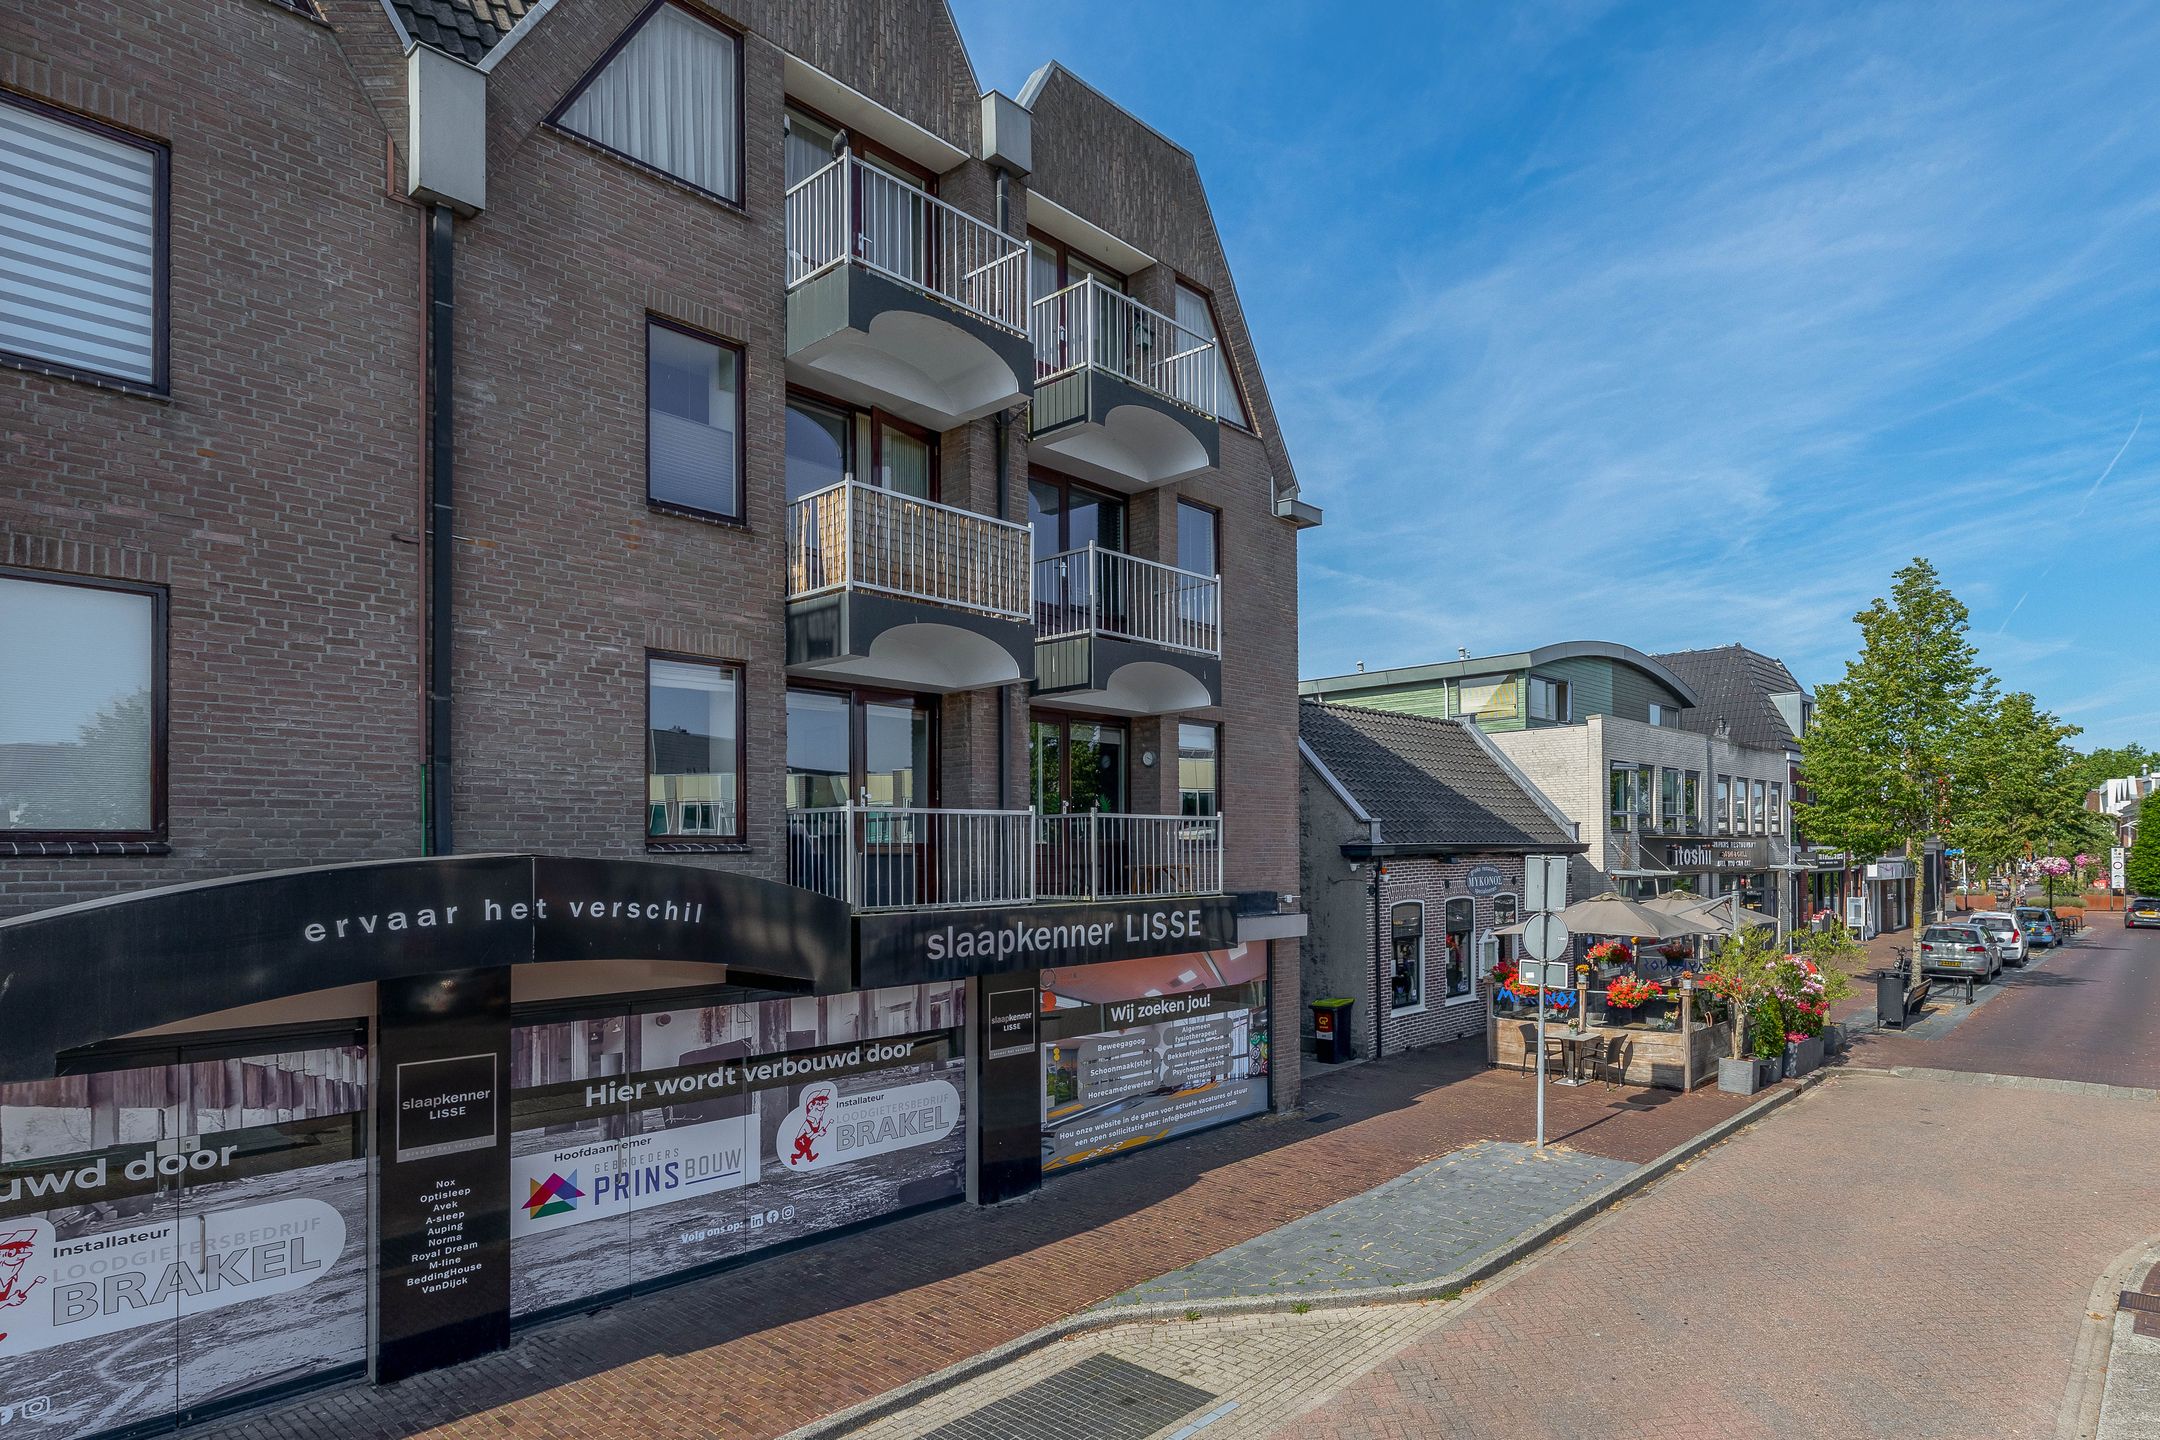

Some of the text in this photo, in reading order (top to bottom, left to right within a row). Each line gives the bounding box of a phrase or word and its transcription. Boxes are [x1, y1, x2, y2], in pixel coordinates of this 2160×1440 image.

[304, 898, 702, 943] ervaar het verschil
[927, 909, 1200, 961] slaapkenner LISSE
[991, 1012, 1032, 1025] slaapkenner
[1110, 994, 1211, 1023] Wij zoeken jou!
[1003, 1022, 1021, 1032] LISSE
[1174, 1029, 1217, 1043] fysiotherapeut
[1181, 1023, 1211, 1034] Algemeen
[1097, 1037, 1146, 1052] Beweegagoog
[1167, 1042, 1231, 1061] Bekkenfysiotherapeut
[585, 1041, 915, 1108] Hier wordt verbouwd door
[1090, 1058, 1152, 1077] Schoonmaak(st)er
[1172, 1059, 1225, 1076] Psychosomatische
[1187, 1069, 1211, 1081] therapie
[402, 1089, 491, 1110] slaapkenner
[1087, 1079, 1155, 1100] Horecamedewerker
[836, 1094, 885, 1109] Installateur
[836, 1093, 949, 1124] LOODGIETERSBEDRIJF
[429, 1106, 466, 1120] LISSE
[1059, 1087, 1248, 1140] Hou onze website in de gaten voor actuele vacatures of stuur
[1074, 1099, 1237, 1147] een open sollicitatie naar: info@bootenbroersen.com
[836, 1106, 950, 1151] BRAKEL
[124, 1144, 238, 1181] door
[594, 1148, 679, 1174] GEBROEDERS
[436, 1179, 456, 1189] Nox
[594, 1147, 741, 1206] PRINS BOUW
[420, 1187, 471, 1203] Optisleep
[433, 1200, 458, 1212] Avek
[425, 1211, 465, 1225] A-sleep
[427, 1222, 464, 1236] Auping
[680, 1228, 705, 1245] Volg
[707, 1225, 725, 1237] ons
[726, 1220, 743, 1236] op:
[53, 1227, 171, 1259] Installateur
[53, 1217, 321, 1284] LOODGIETERSBEDRIJF
[428, 1234, 462, 1247] Norma
[411, 1241, 478, 1263] Royal Dream
[429, 1256, 461, 1270] M-line
[53, 1236, 322, 1327] BRAKEL
[406, 1263, 482, 1287] BeddingHouse
[422, 1277, 468, 1294] VanDijck
